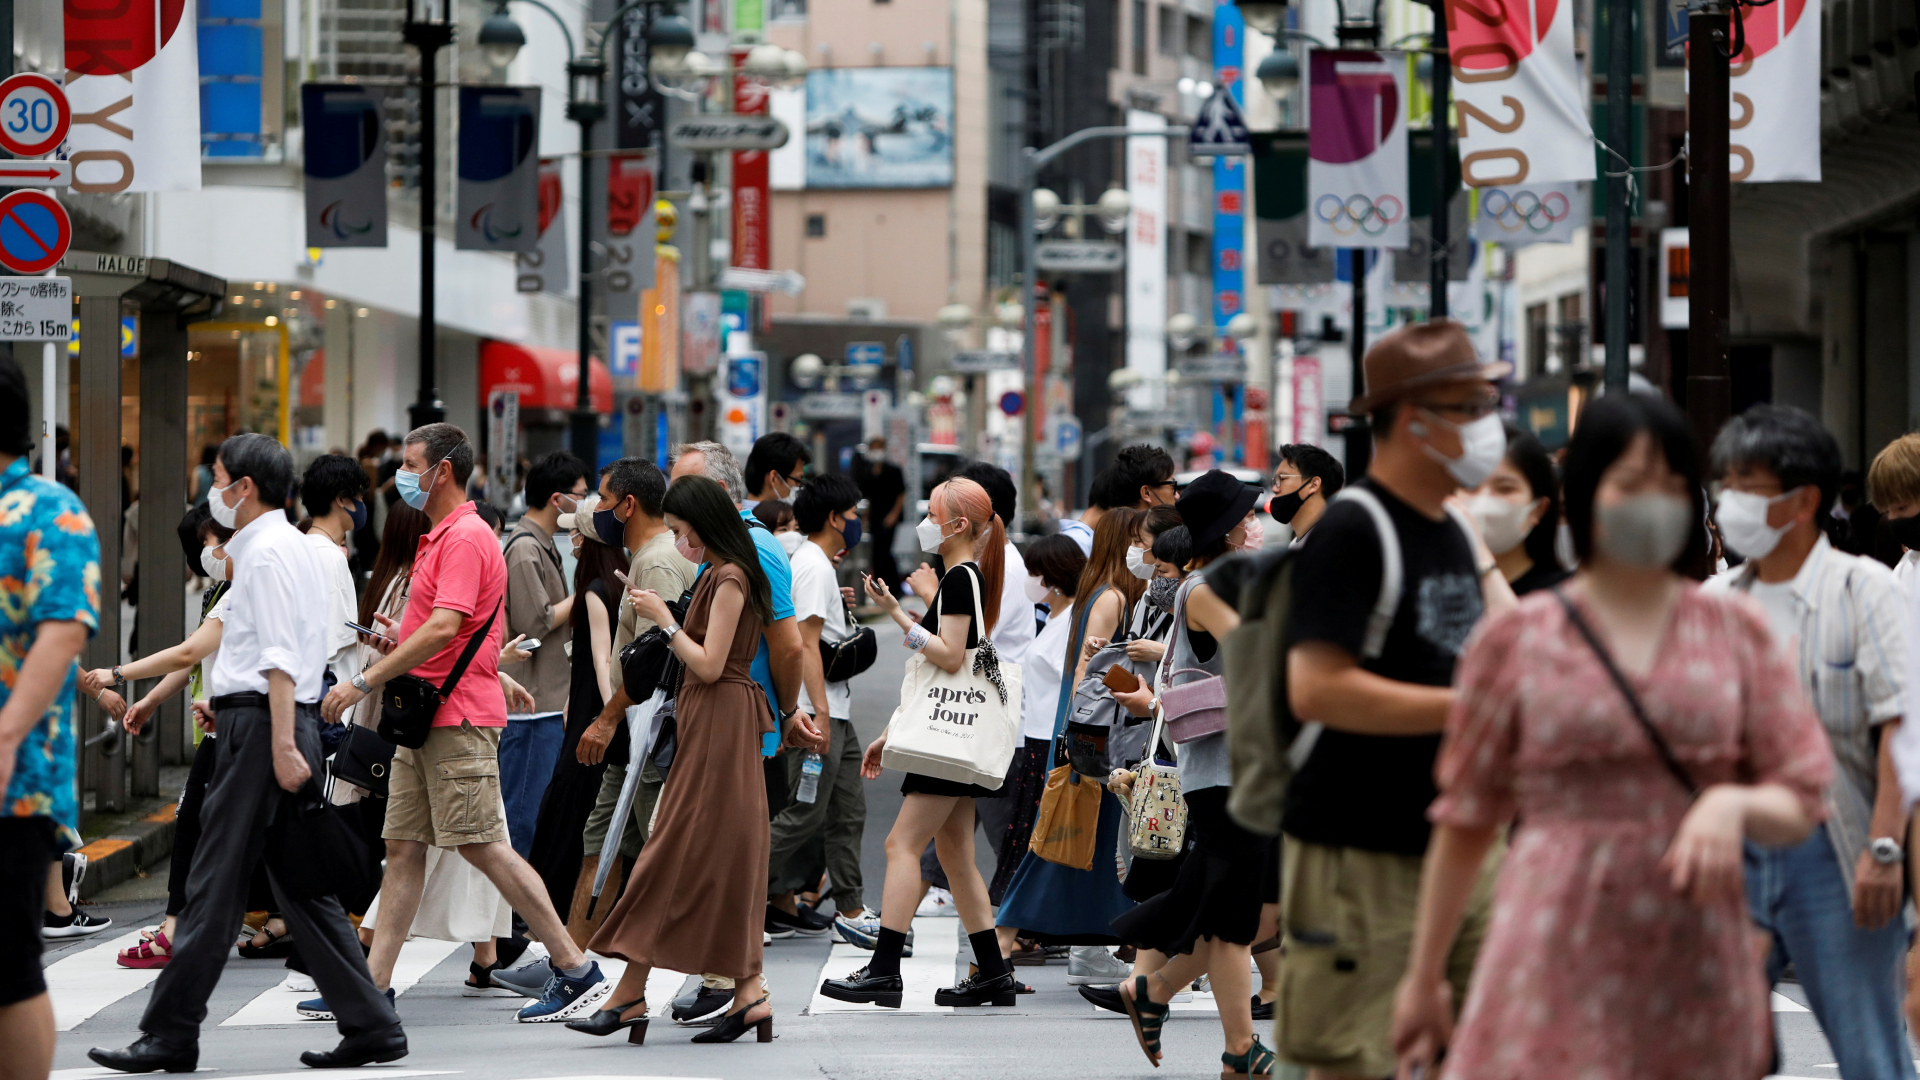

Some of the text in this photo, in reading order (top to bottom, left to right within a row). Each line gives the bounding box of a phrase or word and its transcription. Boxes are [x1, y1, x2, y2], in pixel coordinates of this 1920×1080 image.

[8, 98, 52, 133] 30
[97, 255, 145, 273] HALOE
[0, 282, 67, 298] クシーの客待ち
[40, 320, 68, 337] 15m
[928, 687, 986, 704] après
[929, 703, 978, 725] jour
